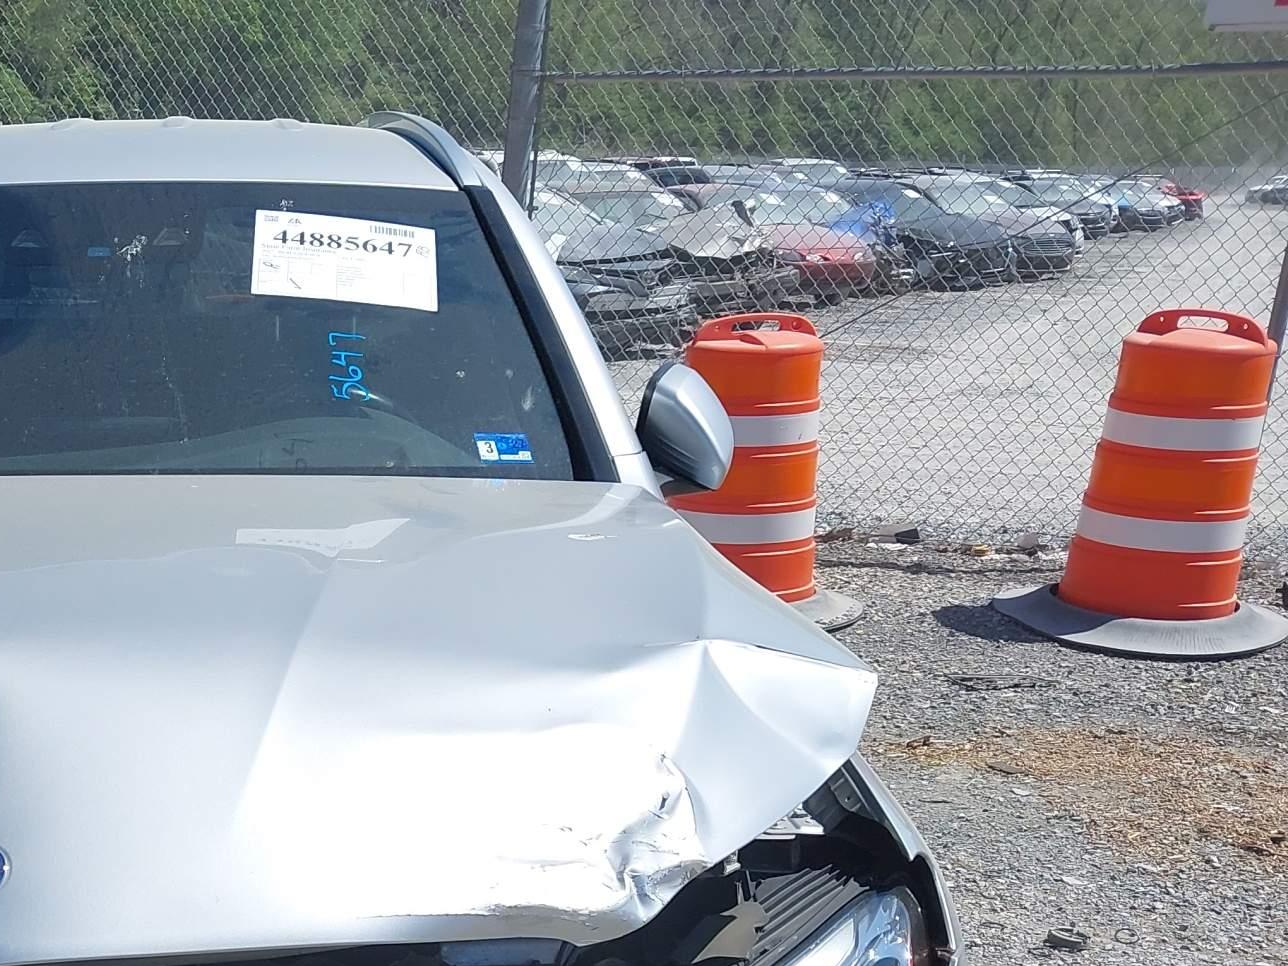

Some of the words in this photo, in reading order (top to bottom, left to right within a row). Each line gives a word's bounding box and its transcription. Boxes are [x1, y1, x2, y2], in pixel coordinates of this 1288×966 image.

[272, 229, 413, 257] 44885647
[328, 331, 367, 402] 5647
[484, 441, 494, 454] 3
